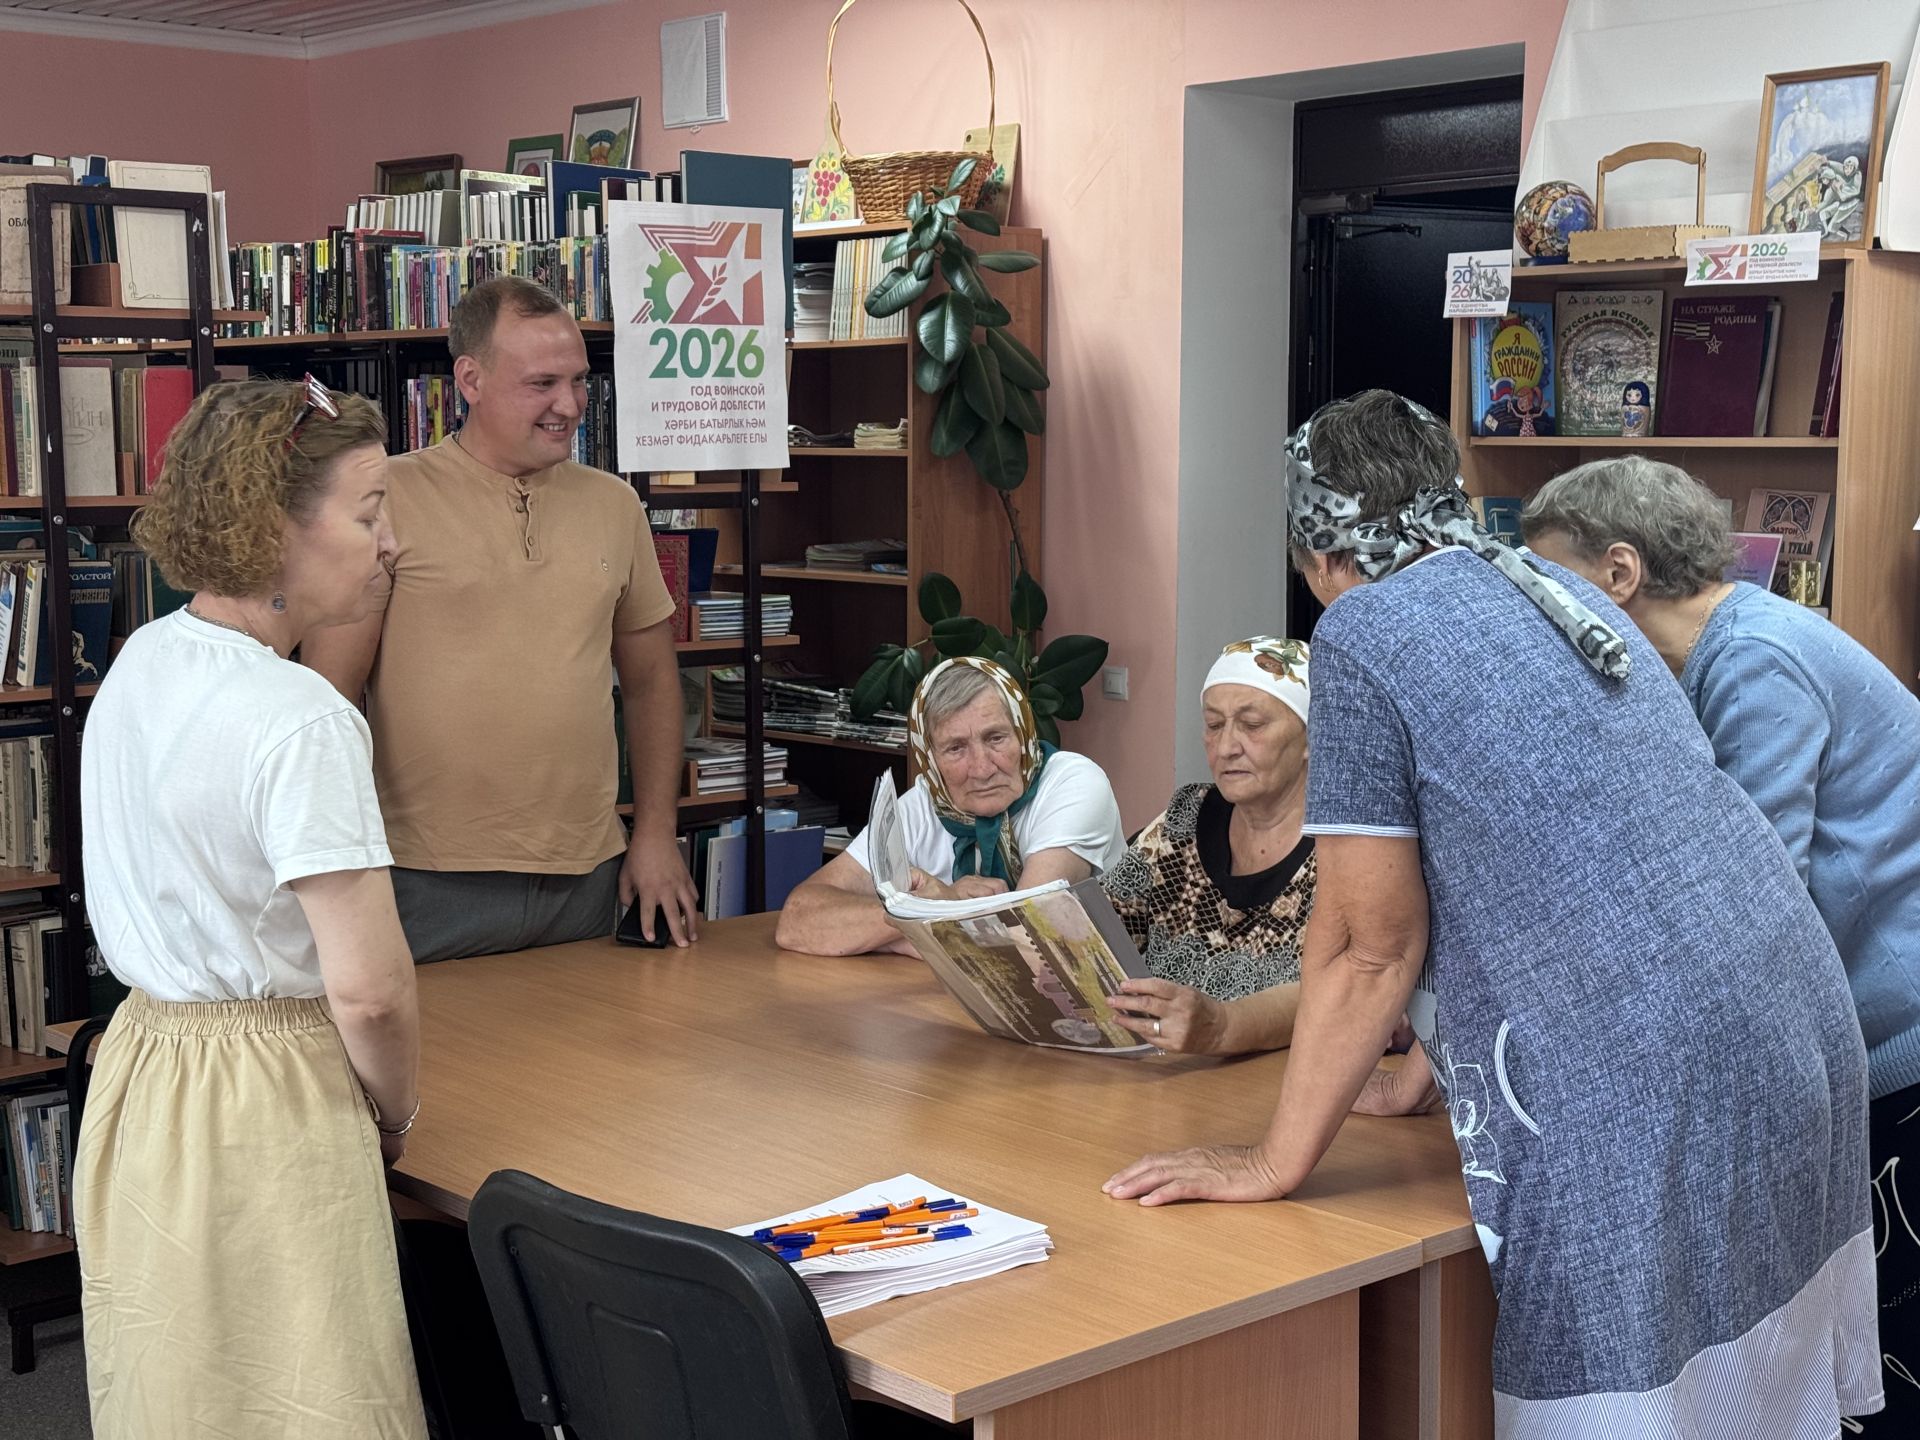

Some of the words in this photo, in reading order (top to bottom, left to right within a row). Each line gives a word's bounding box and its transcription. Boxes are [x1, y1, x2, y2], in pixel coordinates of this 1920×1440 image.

[1750, 242, 1788, 257] 2026
[1452, 269, 1472, 284] 20
[1451, 284, 1470, 299] 26
[1681, 305, 1695, 315] НА
[1697, 304, 1736, 314] СТРАЖЕ
[1611, 308, 1655, 338] ИСТОРИЯ
[1714, 315, 1757, 326] РОДИНЫ
[1512, 332, 1521, 346] Я
[648, 327, 765, 379] 2026
[1494, 345, 1540, 362] ГРАЖДАНИН
[1497, 356, 1538, 381] РОССИИ
[690, 385, 713, 398] ГОД
[714, 383, 765, 397] ВОИНСКОЙ
[651, 401, 659, 413] И
[661, 397, 718, 414] ТРУДОВОЙ
[720, 399, 766, 413] ДОБЛЕСТИ
[664, 419, 697, 431] ХӘРБИ
[700, 418, 745, 430] БАТЫРЛЫК
[635, 434, 674, 447] ХЕЗМӘТ
[676, 432, 748, 446] ФИДАКАРЬЛЕГЕ
[749, 433, 768, 444] ЕЛЫ
[69, 571, 112, 581] ОЛСТОЙ
